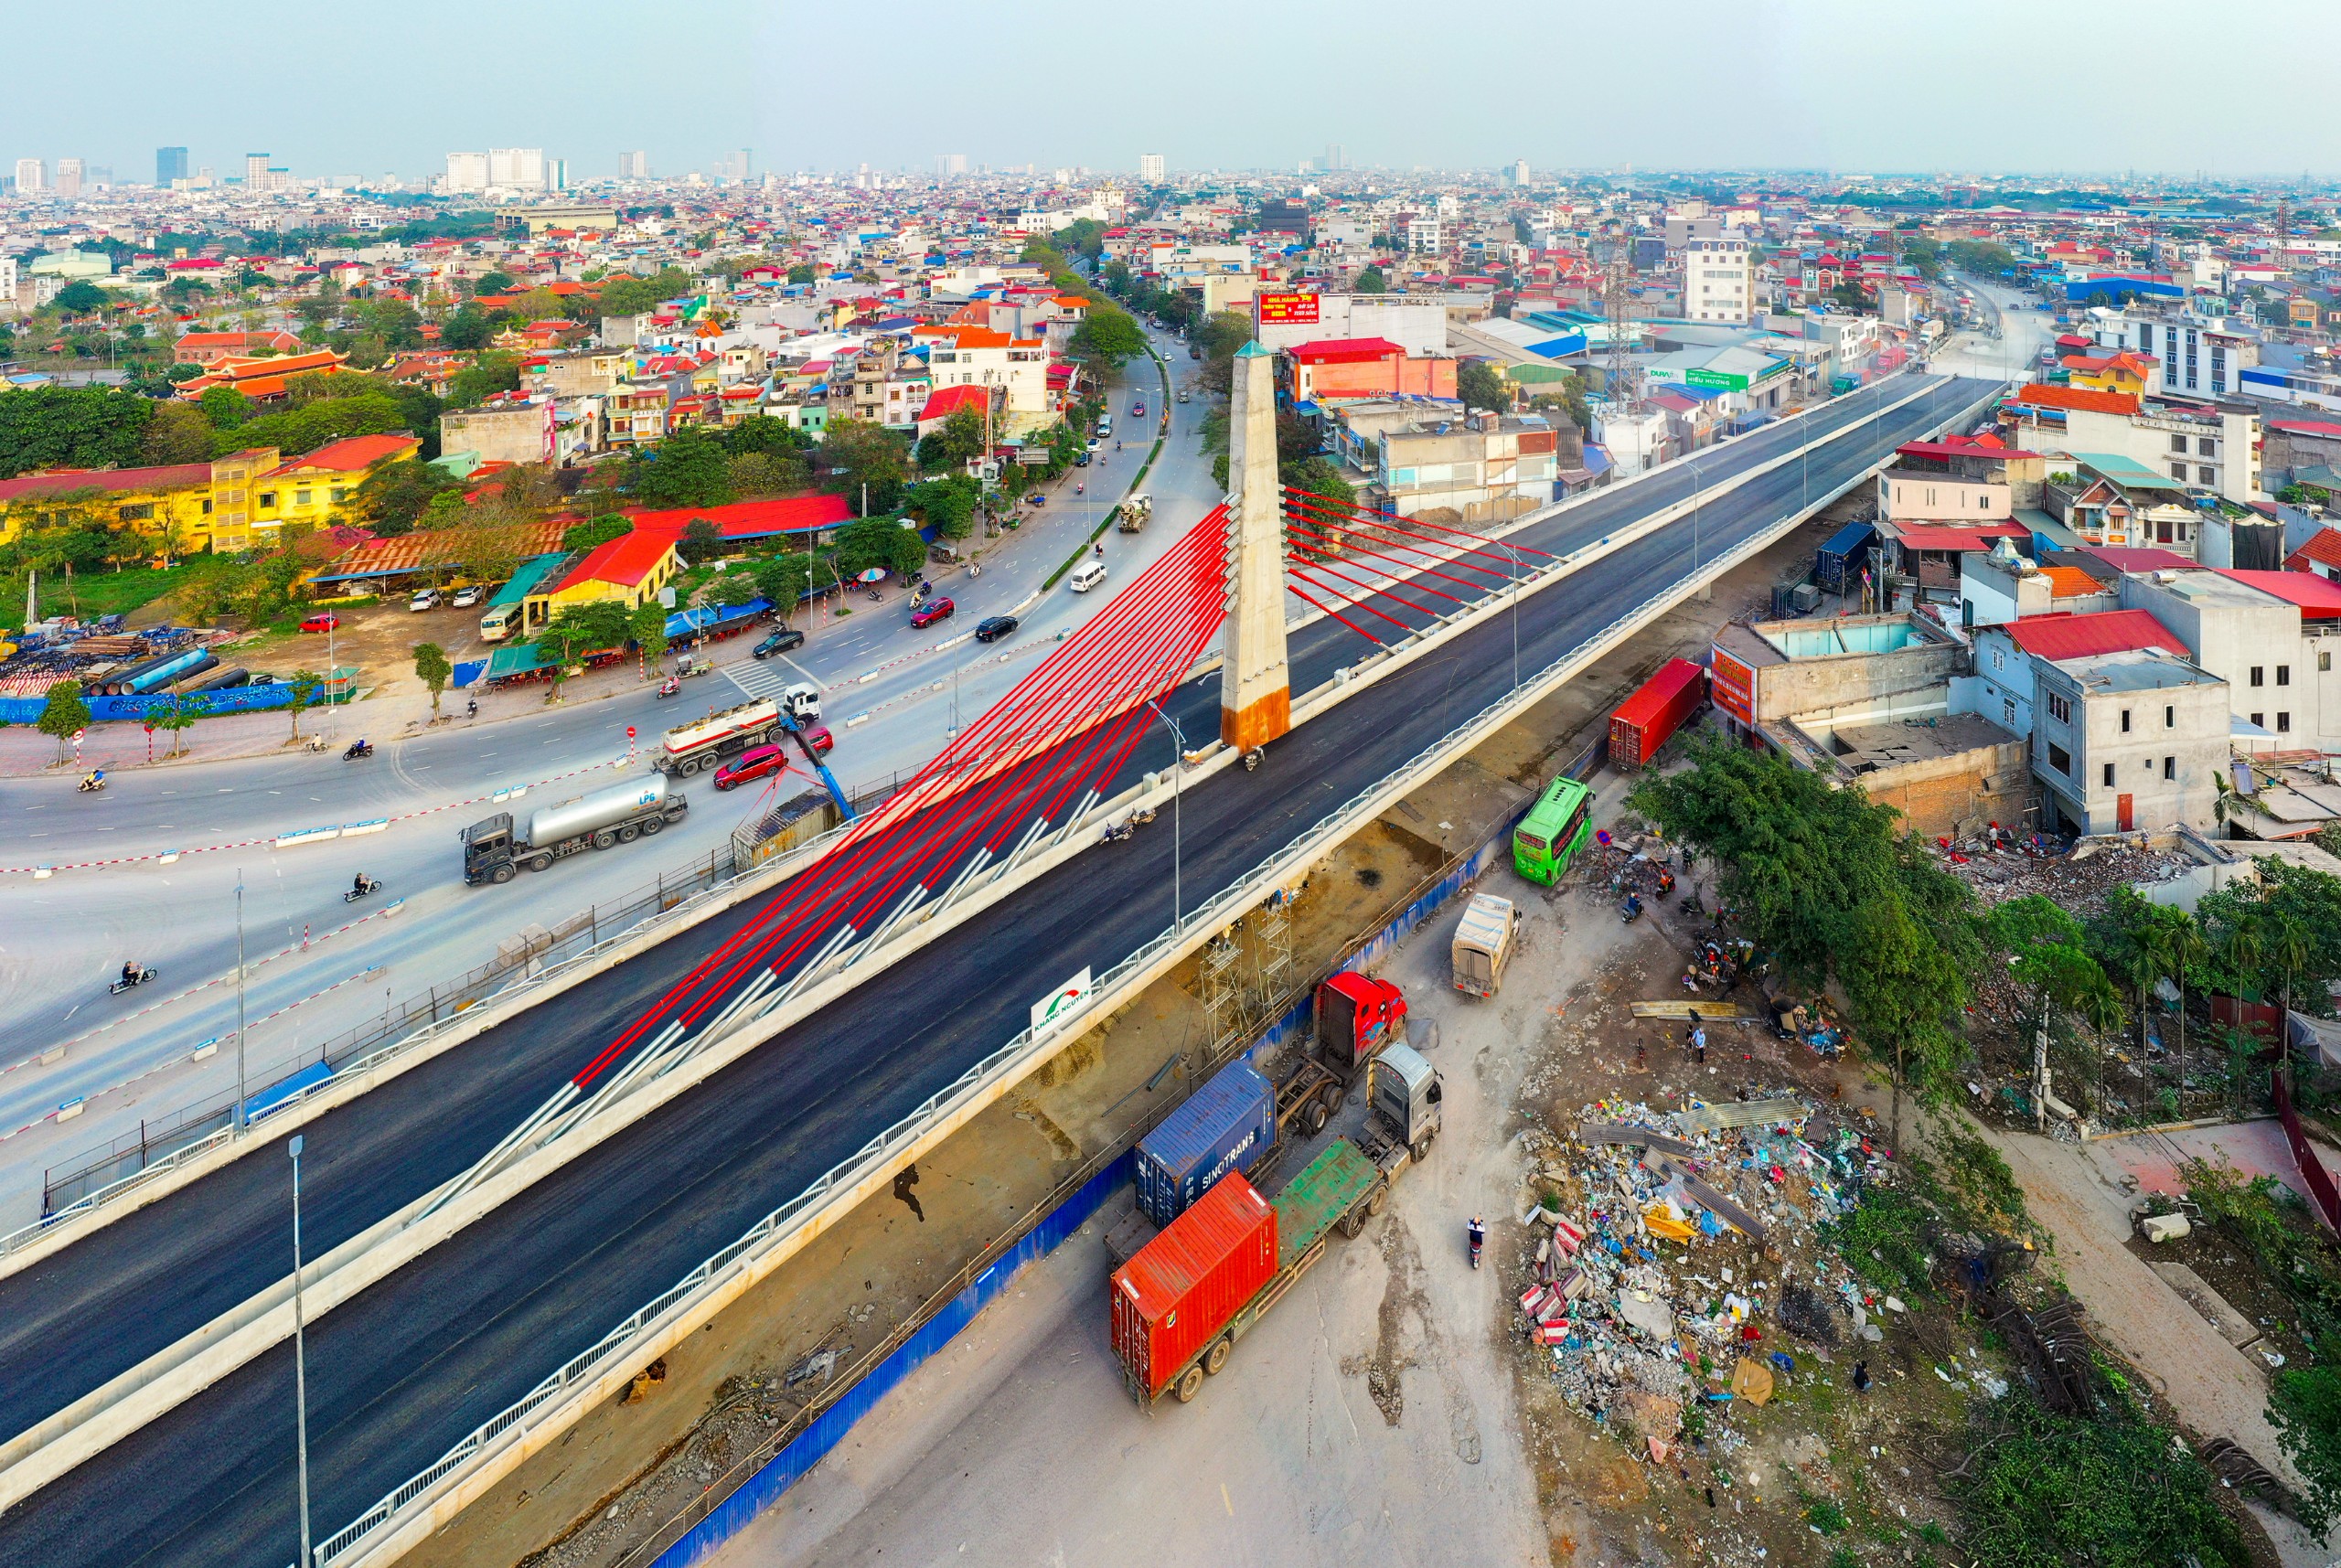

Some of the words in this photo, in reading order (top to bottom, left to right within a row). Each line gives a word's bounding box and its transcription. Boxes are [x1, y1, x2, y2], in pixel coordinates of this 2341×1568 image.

[639, 793, 656, 805] LPG
[1034, 1010, 1060, 1032] KHANG
[1061, 988, 1089, 1013] NGUYÊN
[1202, 1130, 1255, 1190] SINOTRANS
